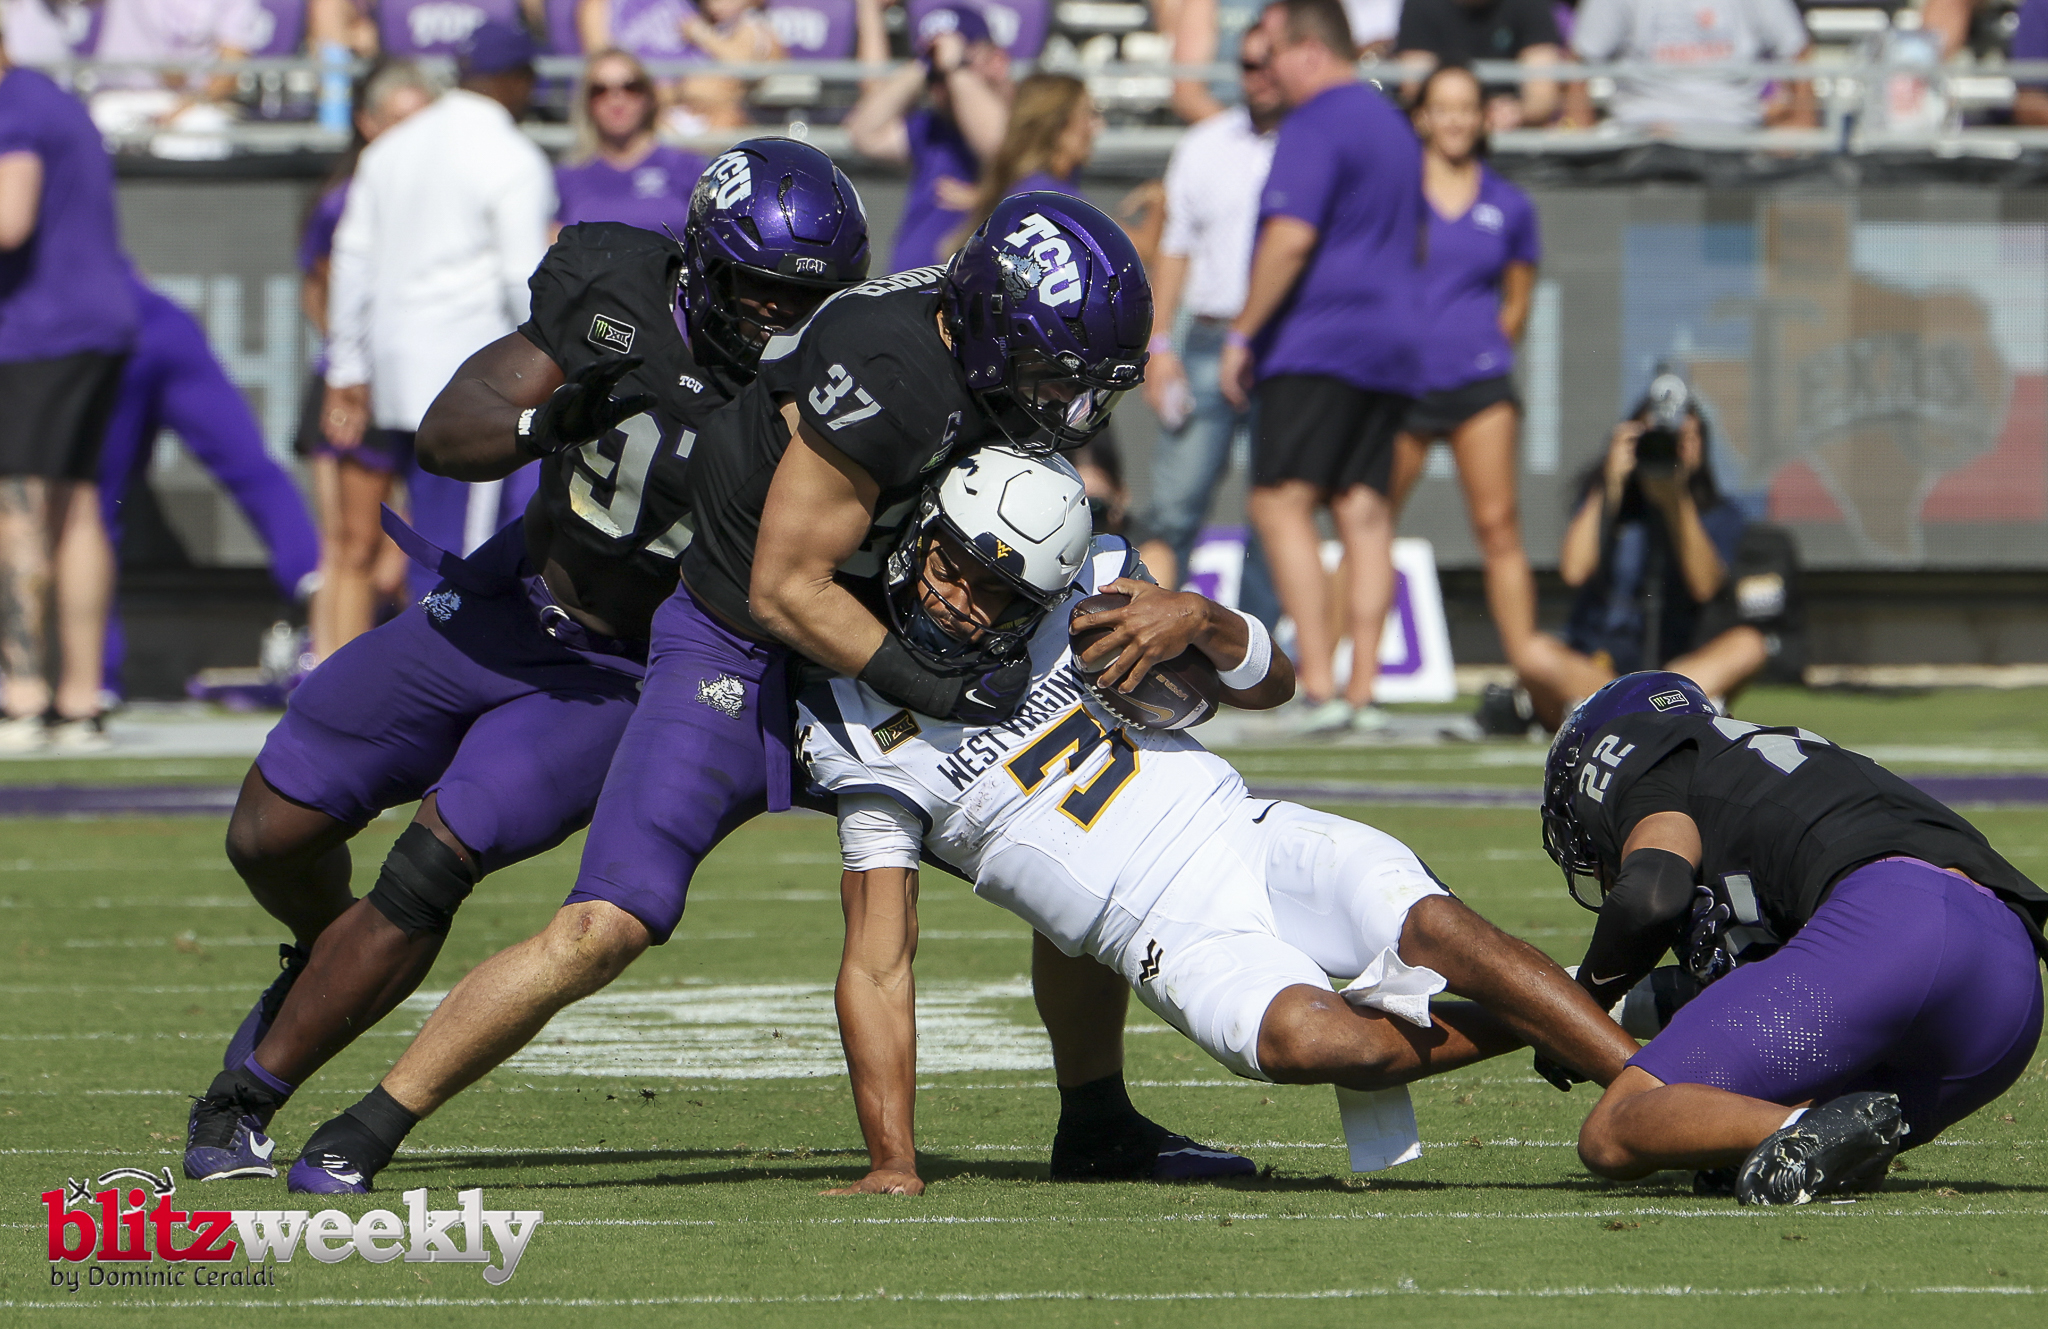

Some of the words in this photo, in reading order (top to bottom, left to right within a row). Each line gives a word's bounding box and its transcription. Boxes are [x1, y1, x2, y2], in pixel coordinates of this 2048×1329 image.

[702, 151, 751, 209] TCU
[796, 258, 827, 274] TCU
[1004, 213, 1082, 307] TCU
[679, 375, 704, 394] TCU
[808, 364, 882, 431] 37
[937, 728, 1010, 792] WEST
[999, 664, 1086, 738] VIRGINI
[1002, 703, 1141, 833] 3
[1579, 734, 1636, 804] 22
